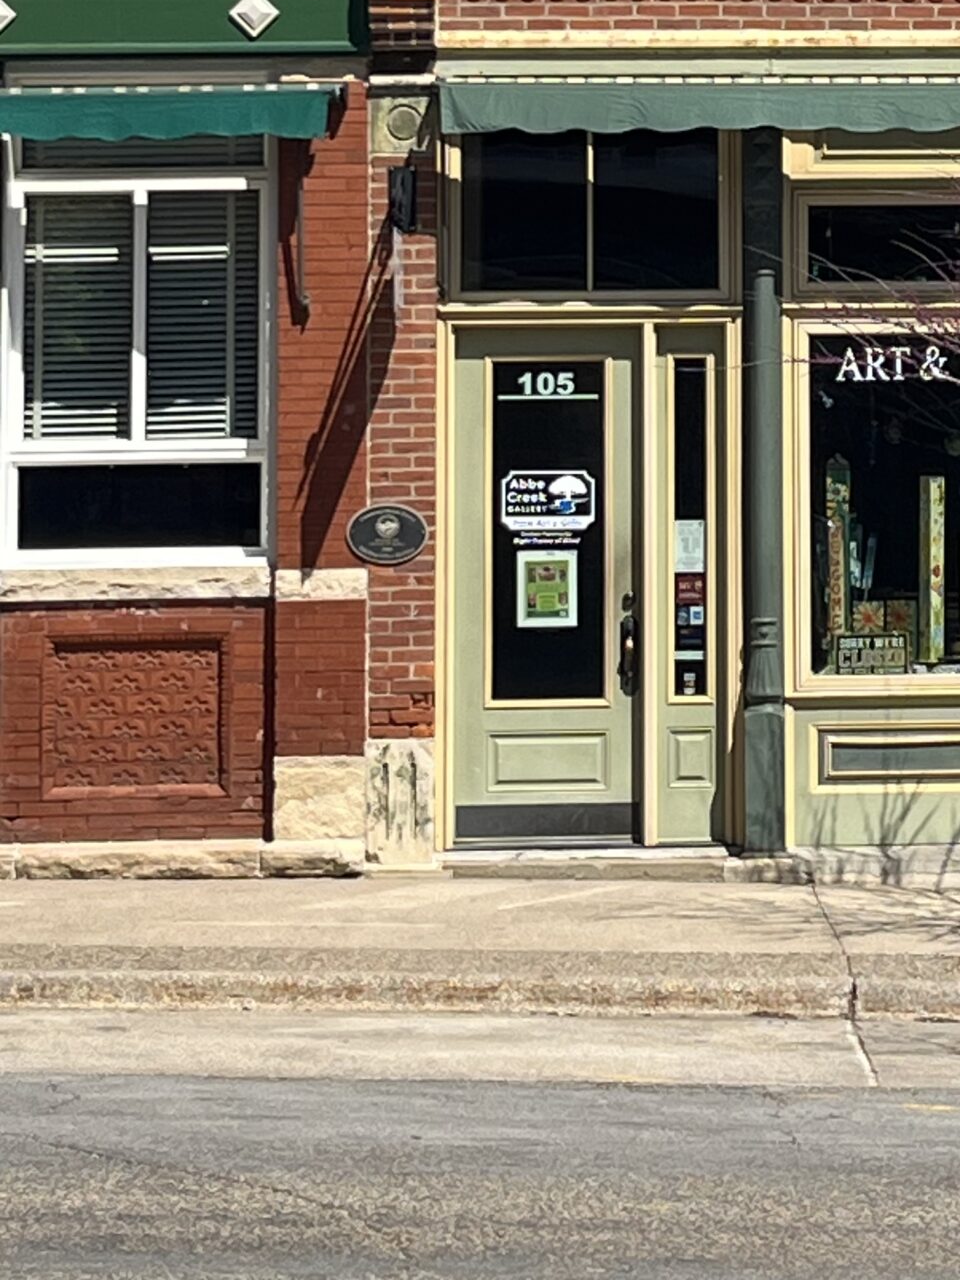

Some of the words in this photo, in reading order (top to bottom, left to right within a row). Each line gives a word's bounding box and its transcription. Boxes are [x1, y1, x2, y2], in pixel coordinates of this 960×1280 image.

[835, 345, 911, 381] ART
[919, 345, 948, 381] &
[518, 372, 575, 395] 105
[510, 478, 546, 490] Abbe
[507, 491, 548, 503] Creek
